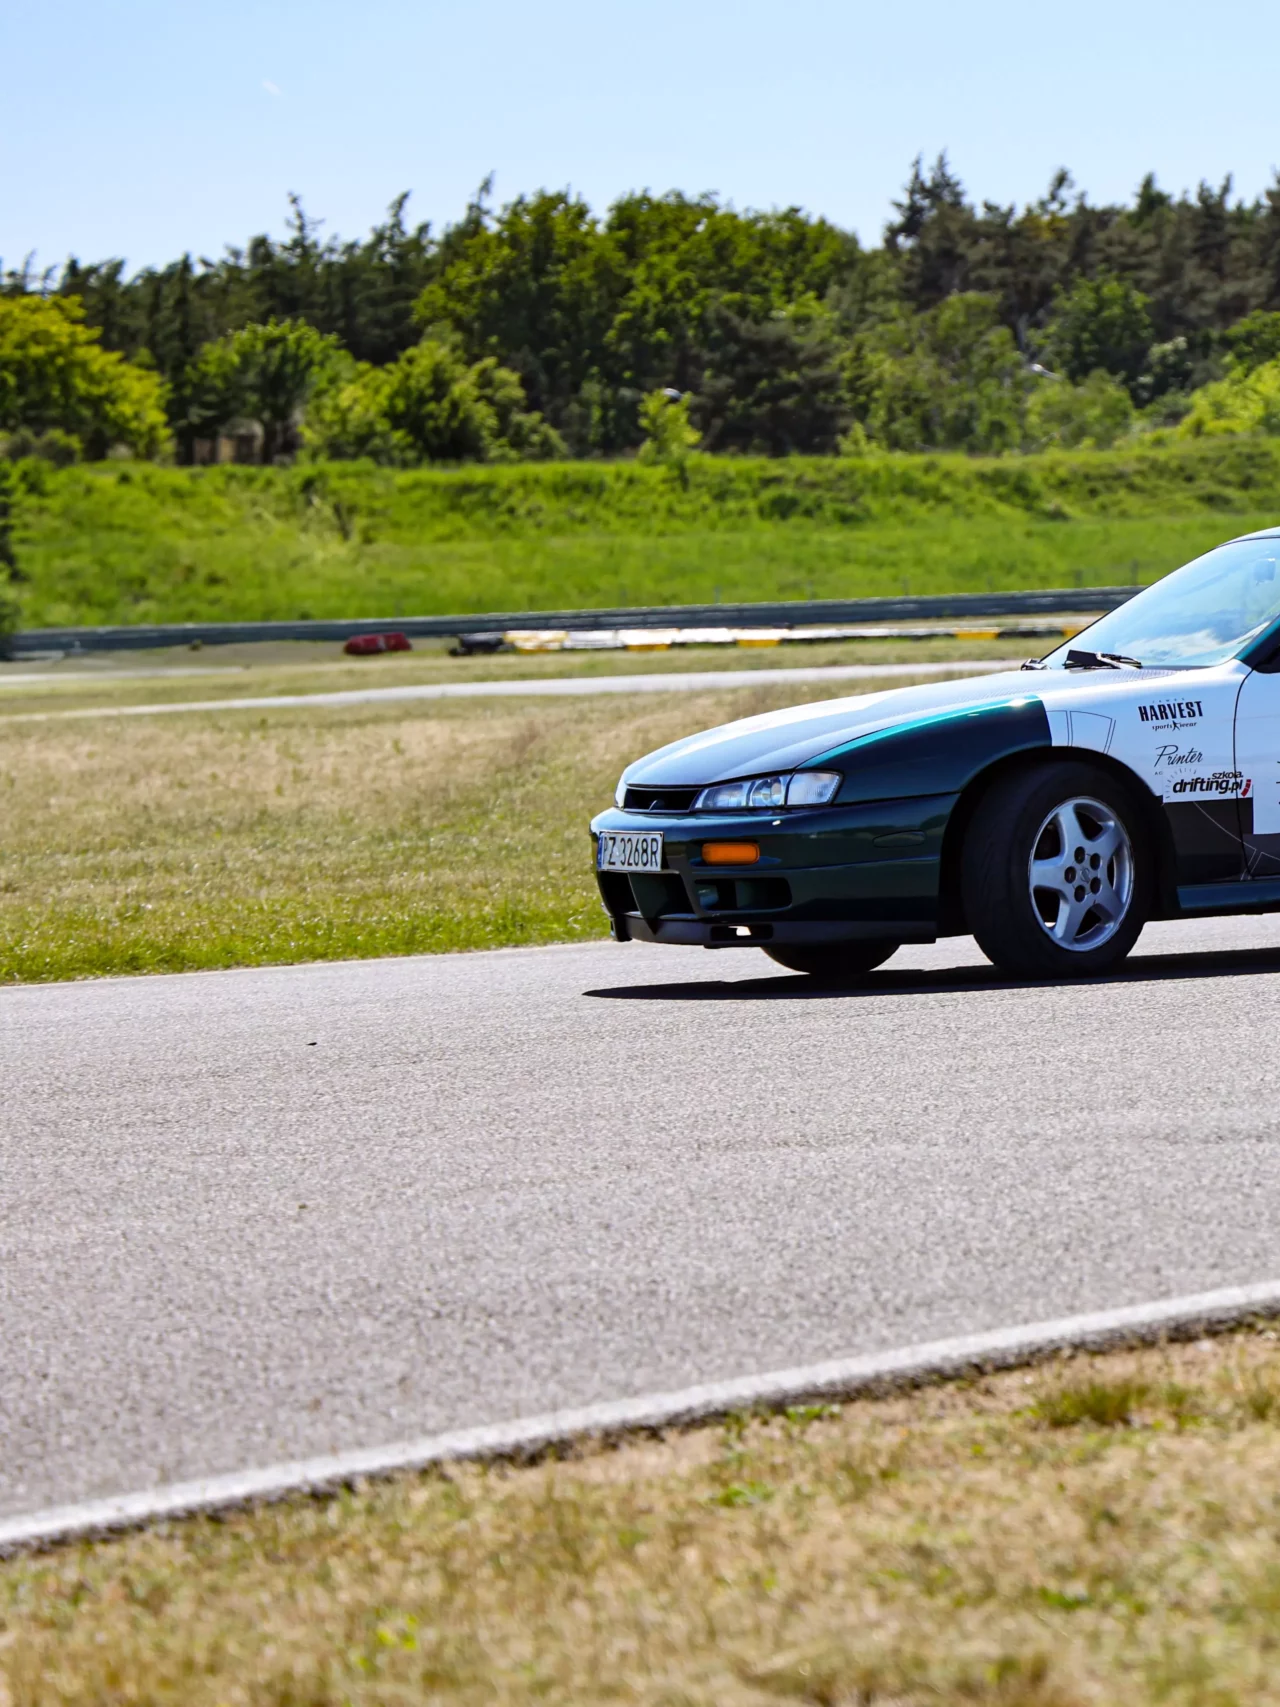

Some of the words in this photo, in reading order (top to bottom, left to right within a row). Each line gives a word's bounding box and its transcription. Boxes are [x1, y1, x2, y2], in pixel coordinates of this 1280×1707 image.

[1138, 701, 1203, 721] HARVEST
[1154, 744, 1203, 767] Printer
[1172, 777, 1243, 795] drifting.pl
[620, 837, 659, 867] 3268R
